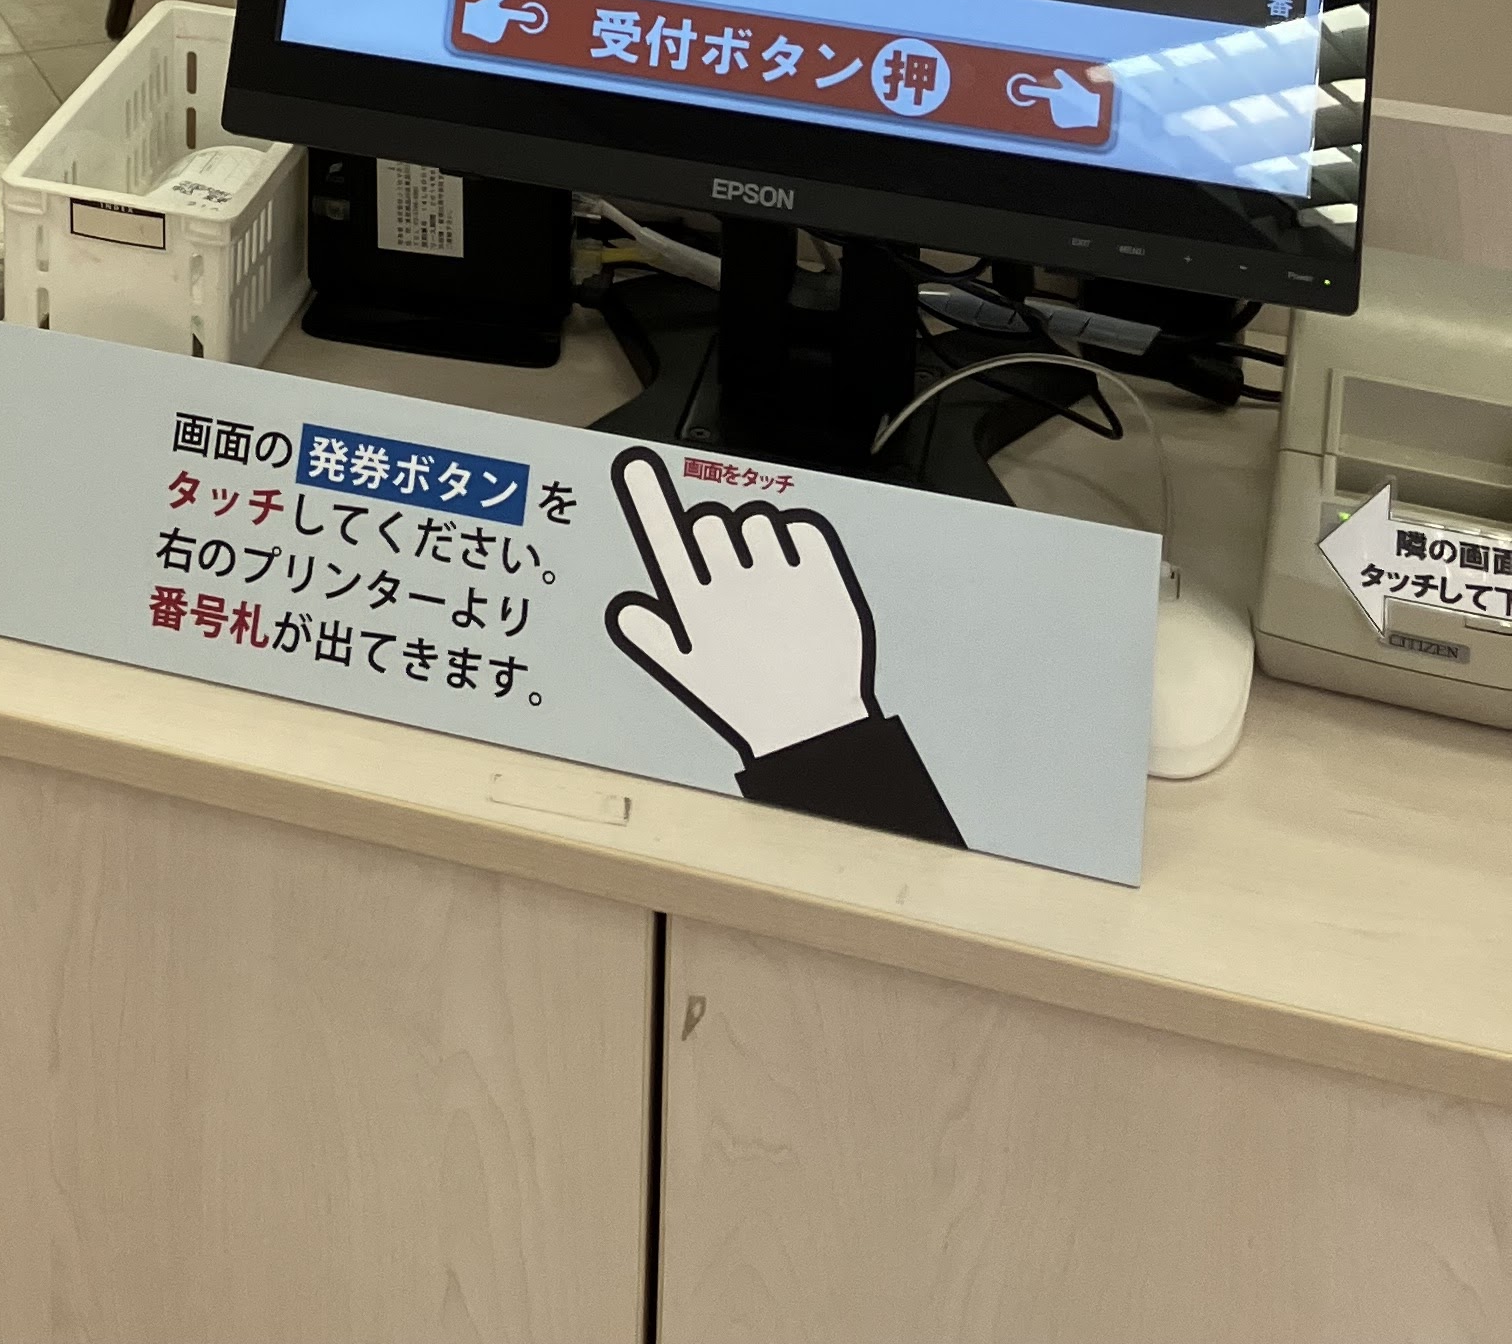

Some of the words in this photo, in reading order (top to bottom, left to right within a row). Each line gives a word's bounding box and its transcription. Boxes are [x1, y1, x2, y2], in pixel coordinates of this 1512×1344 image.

[590, 8, 864, 90] 受付ボタン
[882, 48, 940, 108] 押
[711, 176, 796, 212] EPSON
[683, 455, 795, 494] 画面をタッチ
[167, 469, 557, 587] タッチしてください。
[156, 526, 532, 639] 右のプリンターより
[149, 585, 544, 708] 番号札が出てきます。
[1389, 633, 1459, 659] CITIZEN
